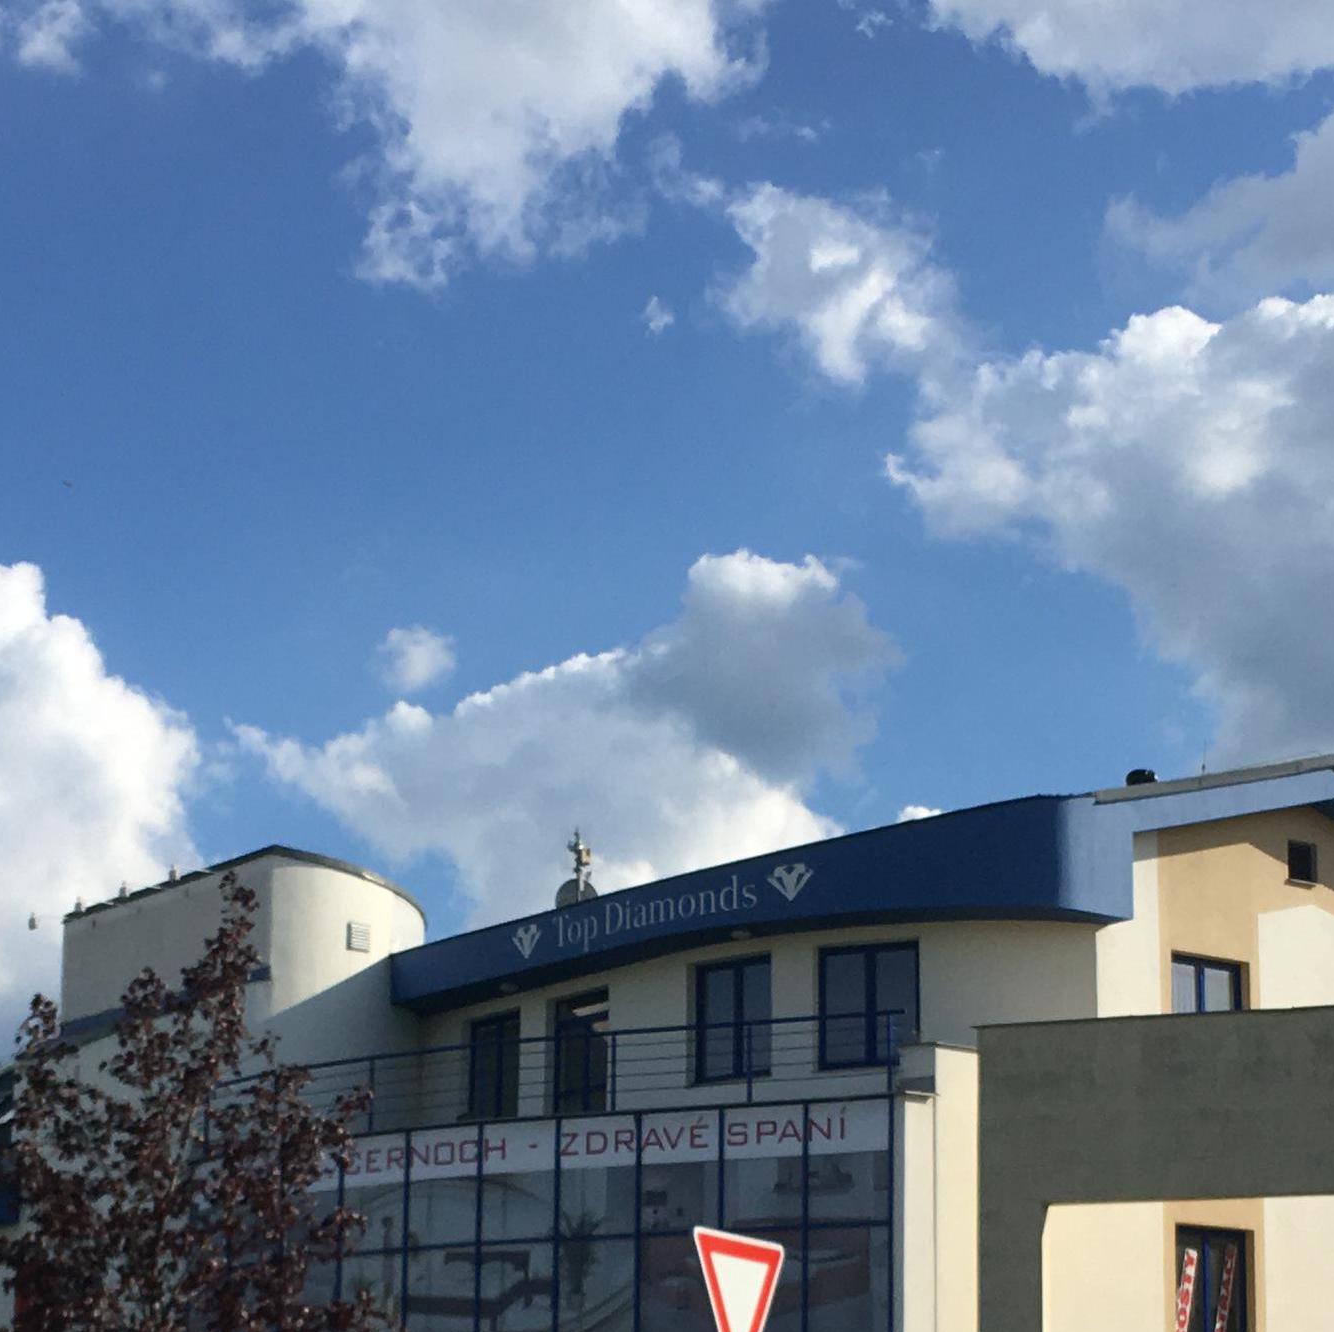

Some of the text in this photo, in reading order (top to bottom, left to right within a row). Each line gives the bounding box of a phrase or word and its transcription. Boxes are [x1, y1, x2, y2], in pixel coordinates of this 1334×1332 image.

[552, 875, 758, 952] Top Diamonds
[559, 1116, 709, 1157] ZDRAVÉ
[726, 1107, 847, 1147] SPANÍ
